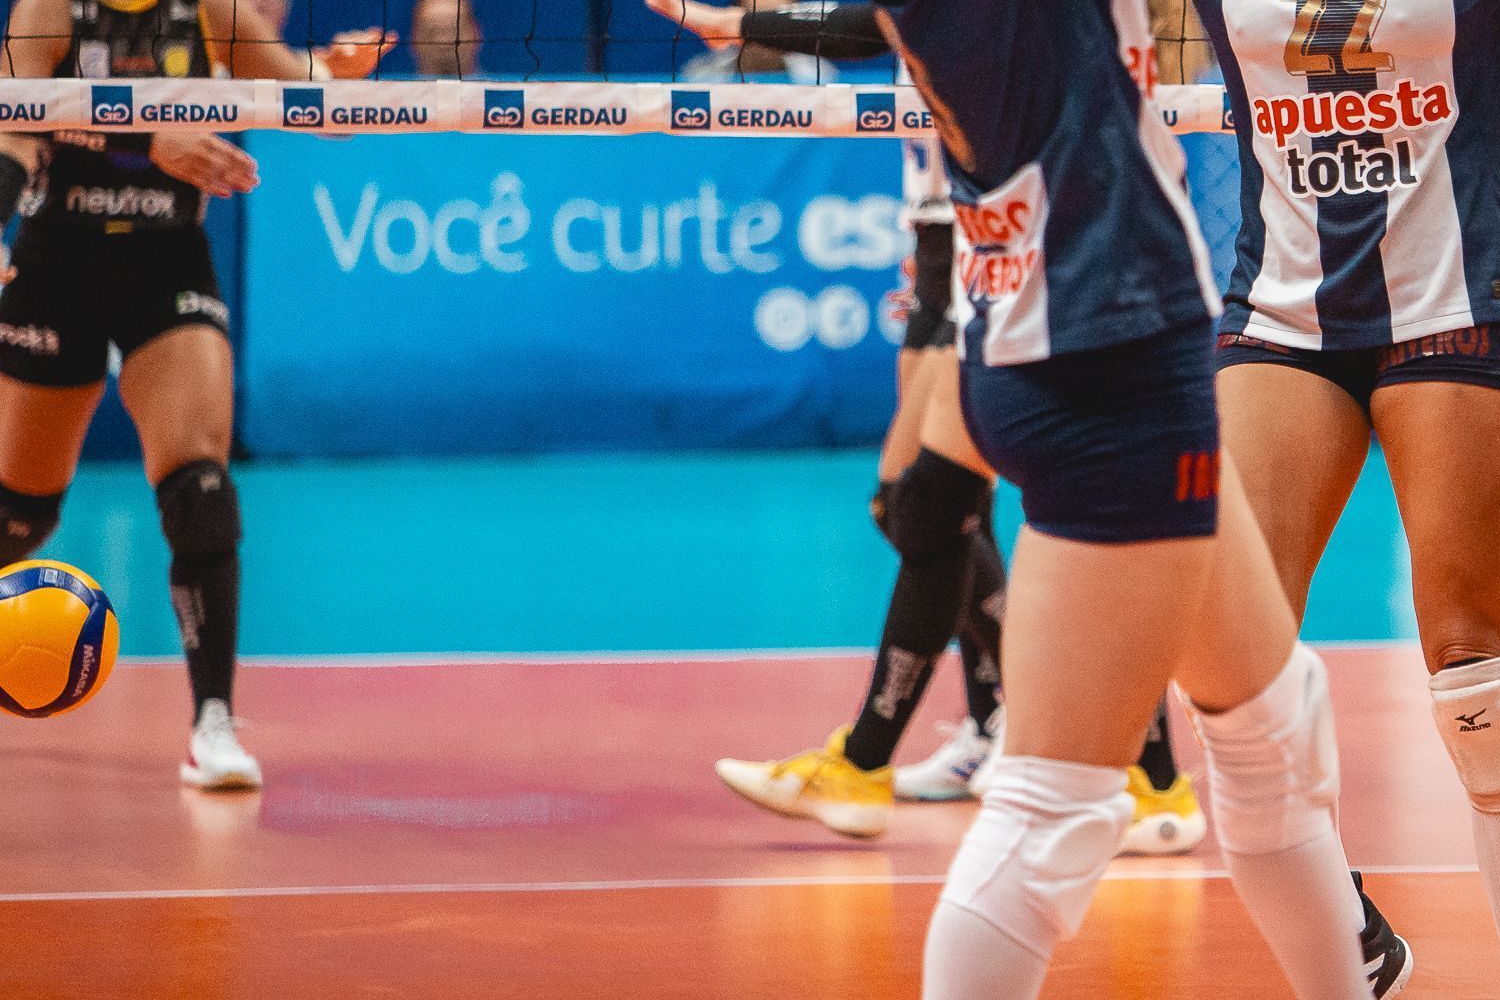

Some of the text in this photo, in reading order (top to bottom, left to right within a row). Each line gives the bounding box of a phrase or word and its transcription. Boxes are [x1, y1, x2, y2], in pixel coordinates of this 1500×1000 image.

[0, 103, 46, 122] DAU
[140, 103, 238, 123] GERDAU
[331, 107, 428, 125] GERDAU
[531, 107, 627, 125] GERDAU
[718, 109, 813, 128] GERDAU
[1255, 80, 1452, 147] apuesta
[1288, 138, 1418, 195] total
[313, 172, 531, 273] Você
[552, 183, 782, 273] curte
